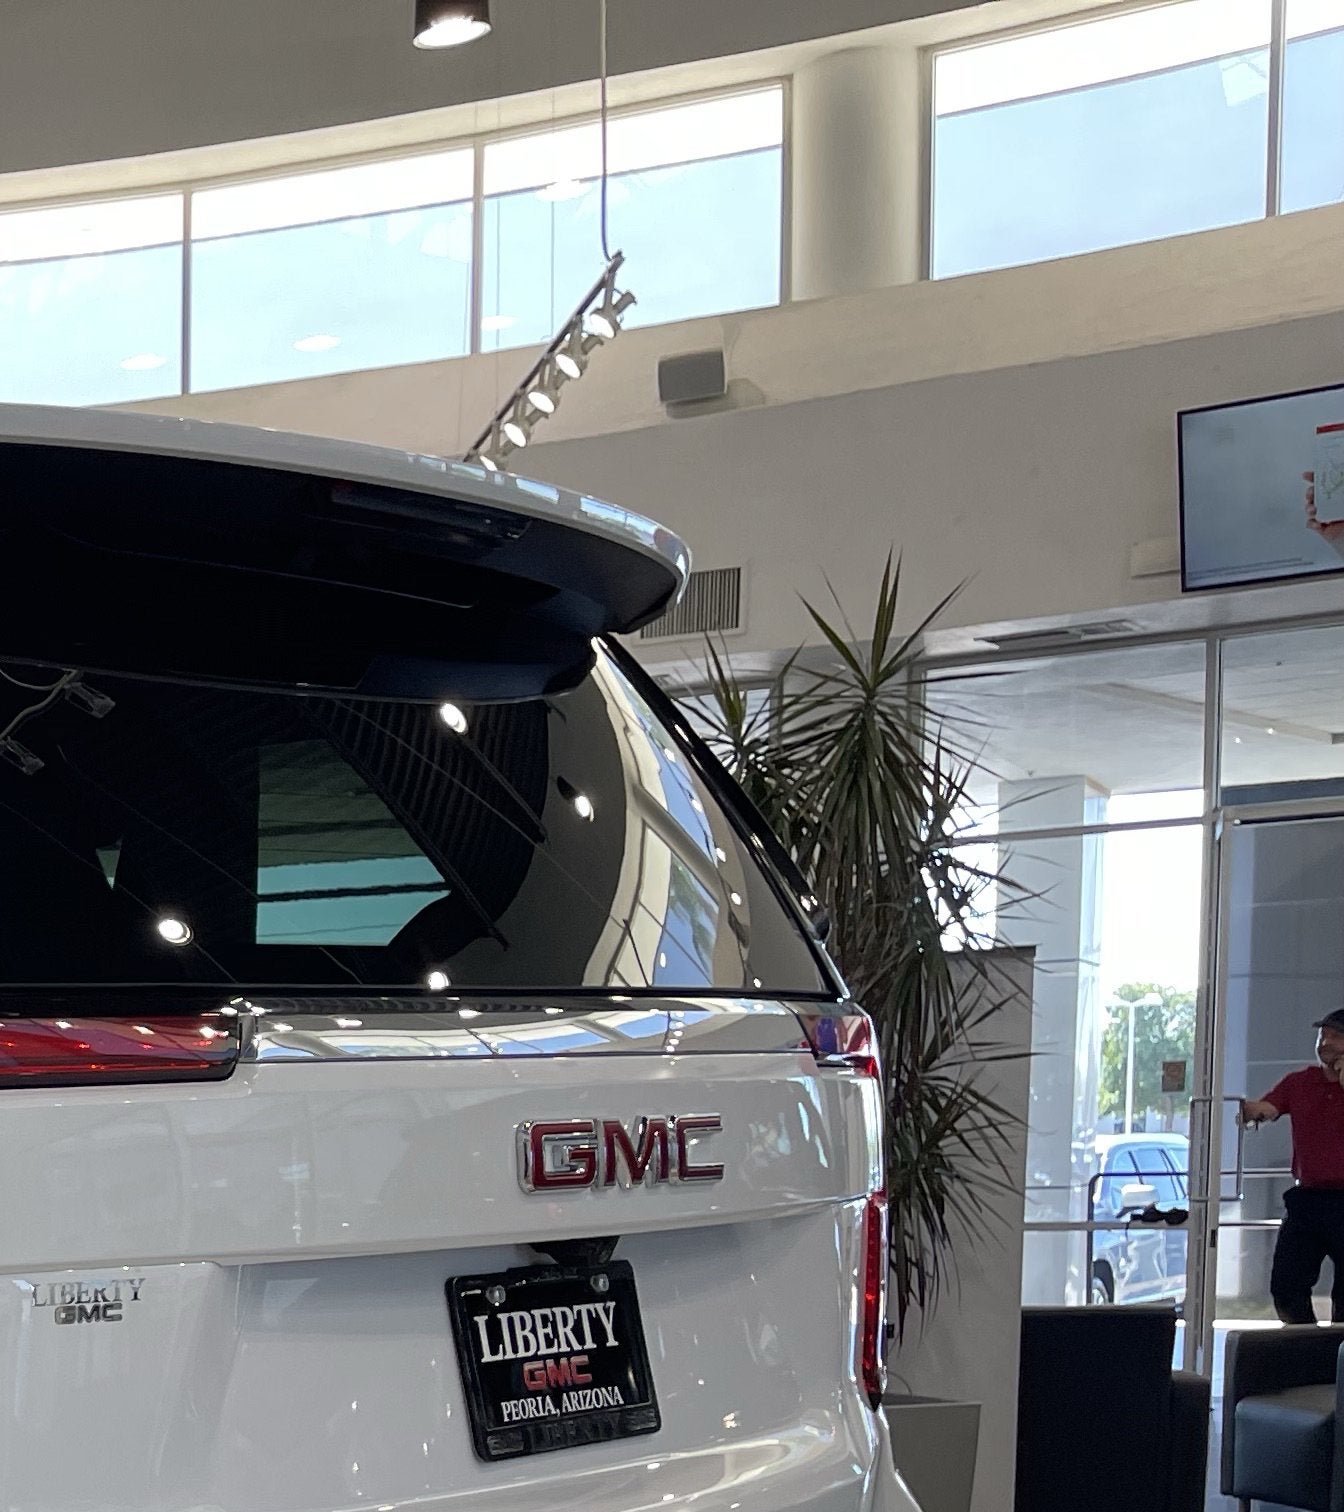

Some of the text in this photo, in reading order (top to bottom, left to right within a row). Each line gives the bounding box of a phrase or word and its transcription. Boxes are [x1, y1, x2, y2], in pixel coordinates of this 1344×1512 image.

[515, 1112, 725, 1197] GMC
[32, 1278, 146, 1307] LIBERTY
[54, 1302, 123, 1325] GMC
[473, 1301, 619, 1363] LIBERTY
[522, 1355, 593, 1391] GMC
[501, 1386, 625, 1422] PEORIA, ARIZONA
